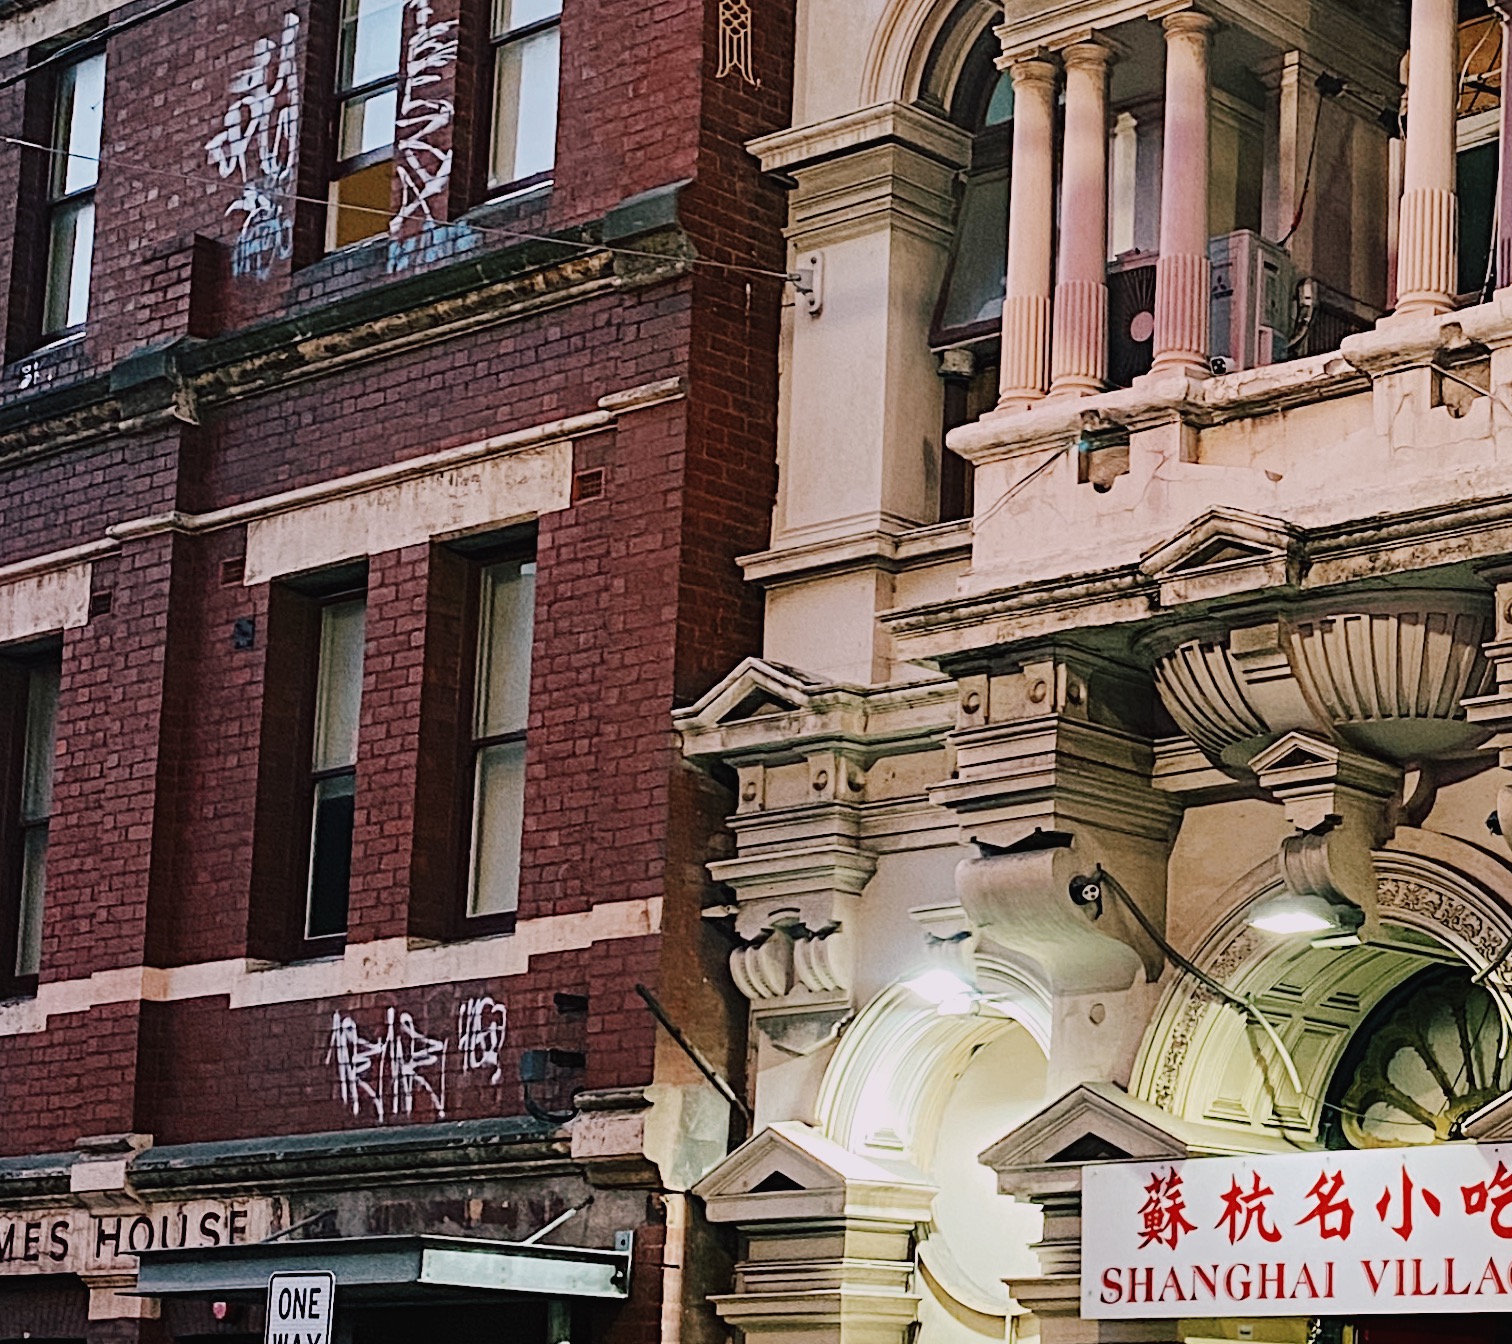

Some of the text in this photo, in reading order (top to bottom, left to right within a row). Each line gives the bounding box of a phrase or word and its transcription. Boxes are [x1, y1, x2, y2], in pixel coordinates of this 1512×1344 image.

[96, 1210, 248, 1258] HOUSE
[278, 1287, 322, 1320] ONE
[1100, 1262, 1335, 1304] SHANGHAI
